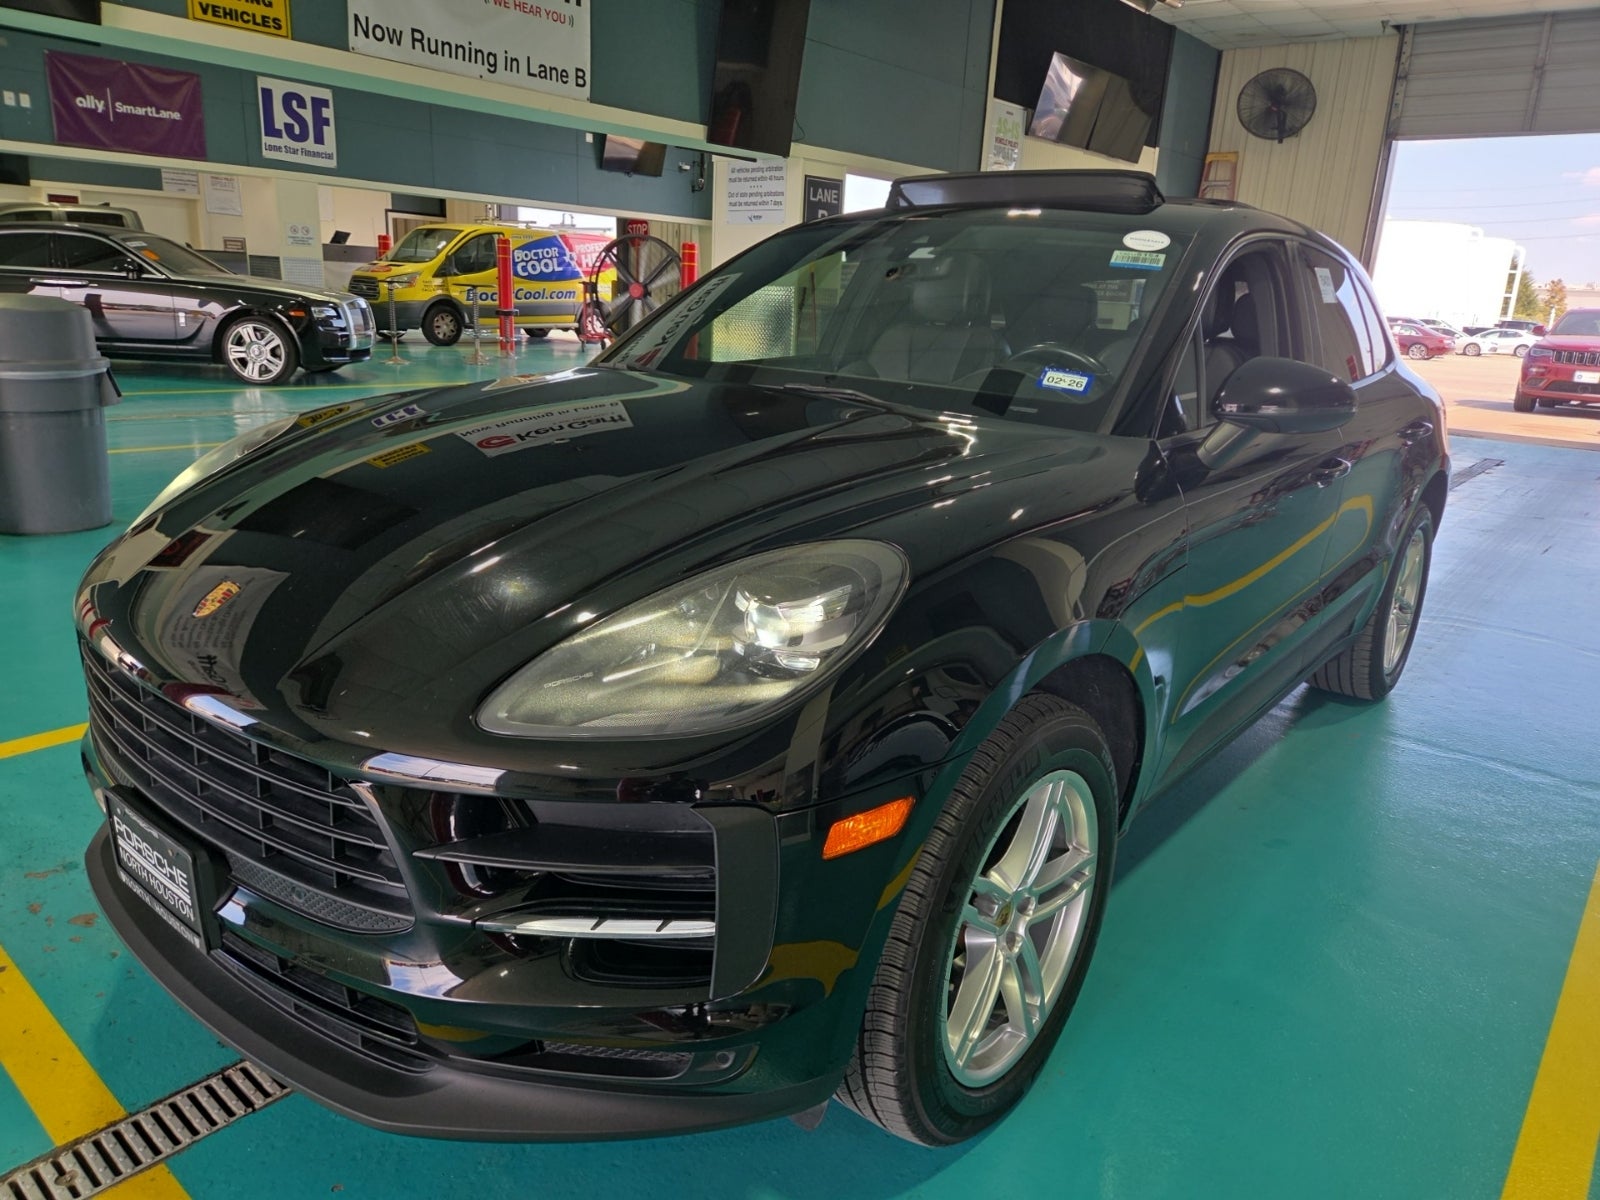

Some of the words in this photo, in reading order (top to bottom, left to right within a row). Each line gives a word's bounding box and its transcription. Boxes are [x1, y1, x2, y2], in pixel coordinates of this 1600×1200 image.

[198, 1, 283, 31] VEHICLES
[492, 0, 511, 9] WE
[513, 1, 542, 18] HEAR
[544, 7, 566, 25] YOU
[353, 13, 403, 46] Now
[410, 27, 498, 74] Running
[504, 50, 520, 75] in
[527, 56, 570, 85] Lane
[575, 68, 587, 88] B
[76, 94, 105, 114] ally
[115, 101, 183, 121] SmartLane
[260, 86, 331, 146] LSF
[264, 141, 283, 153] Lone
[284, 144, 300, 156] Star
[301, 147, 335, 161] Financial
[809, 186, 839, 204] LANE
[627, 223, 649, 236] STOP
[513, 247, 559, 263] DOCTOR
[516, 257, 563, 277] COOL
[544, 671, 594, 689] PORSCHE
[113, 814, 190, 895] PORSCHE
[119, 845, 149, 882] NORTH
[149, 871, 195, 922] HOUSTON
